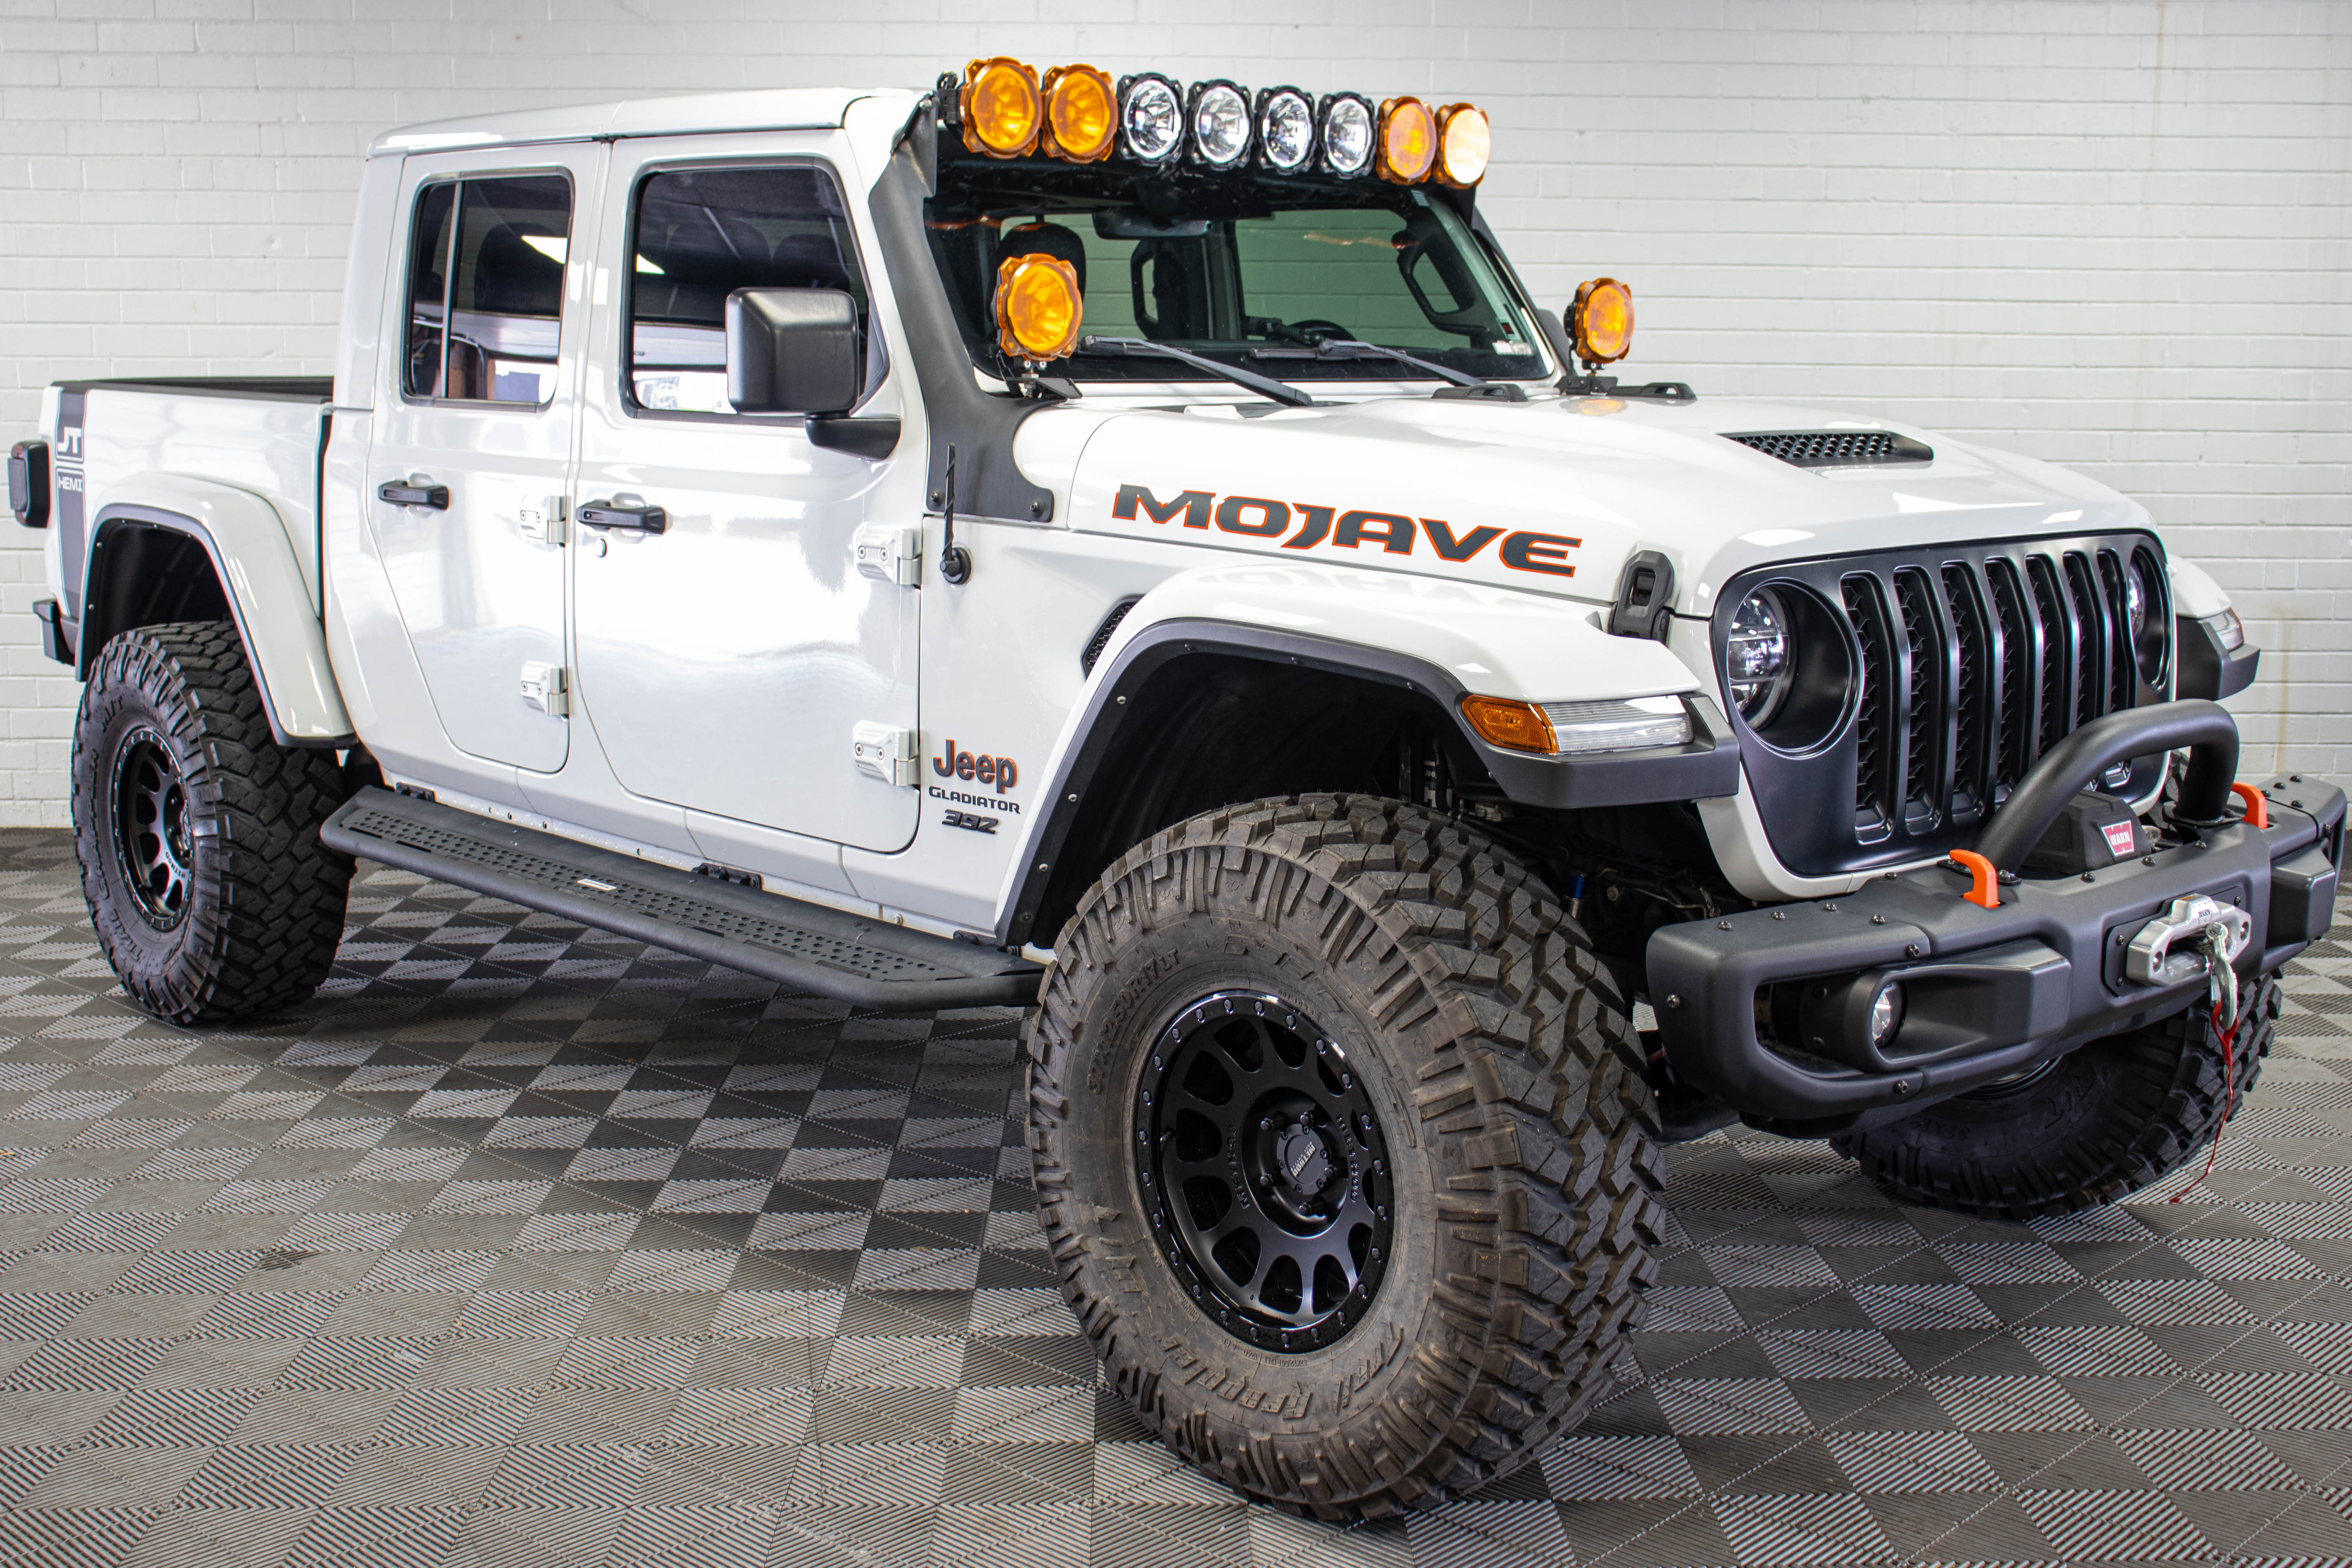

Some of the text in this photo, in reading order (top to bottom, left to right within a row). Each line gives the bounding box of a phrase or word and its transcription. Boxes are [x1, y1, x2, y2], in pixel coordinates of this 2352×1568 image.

[57, 427, 82, 454] JT
[58, 476, 83, 492] HEMI
[1112, 483, 1582, 578] MOJAVE
[933, 739, 1017, 794] Jeep
[1424, 768, 1437, 779] Jee
[929, 786, 1020, 814] GLADIATOR
[942, 809, 1000, 835] 392
[2109, 831, 2131, 846] WARN
[2198, 908, 2211, 917] WARN
[1226, 1124, 1251, 1210] METHOD
[1292, 1143, 1316, 1178] METHOD
[1335, 1114, 1359, 1204] METHOD
